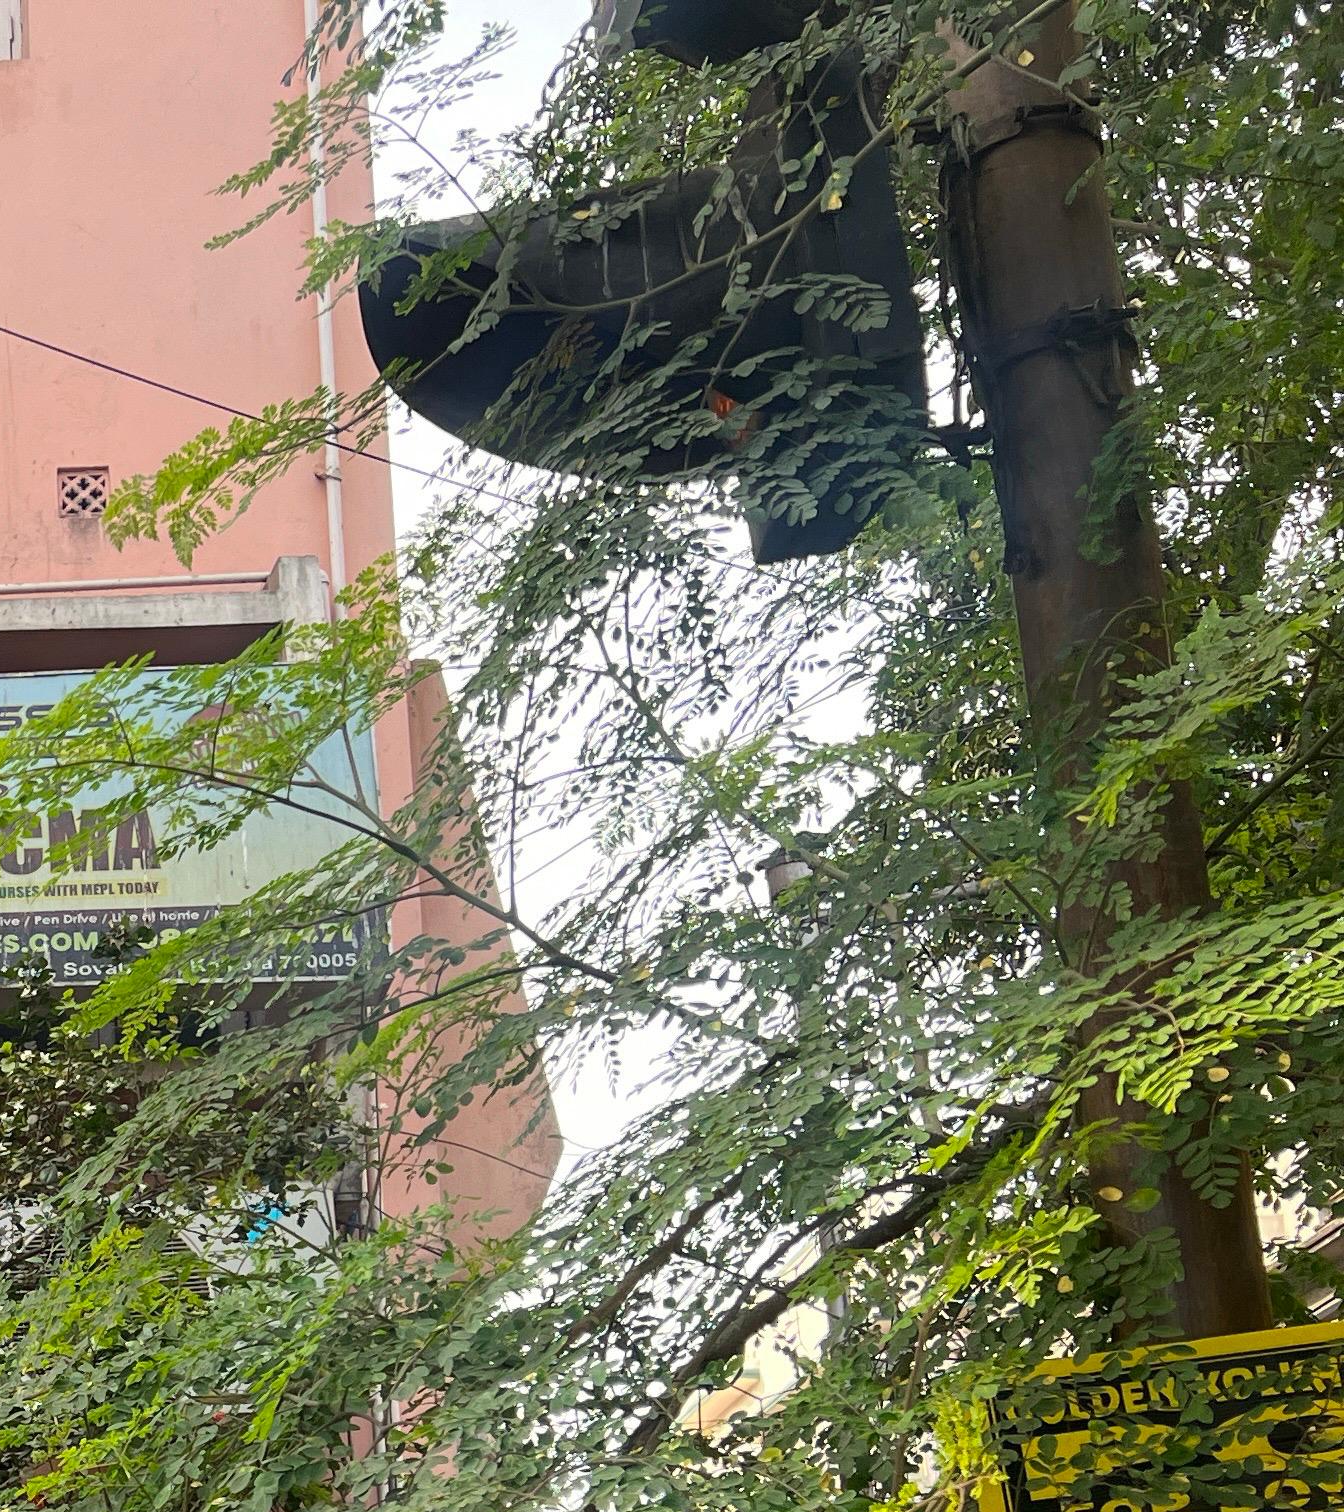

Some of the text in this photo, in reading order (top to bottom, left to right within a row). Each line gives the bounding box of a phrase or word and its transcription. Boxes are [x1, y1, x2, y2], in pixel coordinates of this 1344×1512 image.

[43, 884, 79, 899] WITH
[81, 883, 115, 896] MEPL
[119, 881, 160, 895] TODAY
[35, 914, 60, 925] Pen
[63, 912, 97, 924] Drive
[159, 909, 200, 921] home
